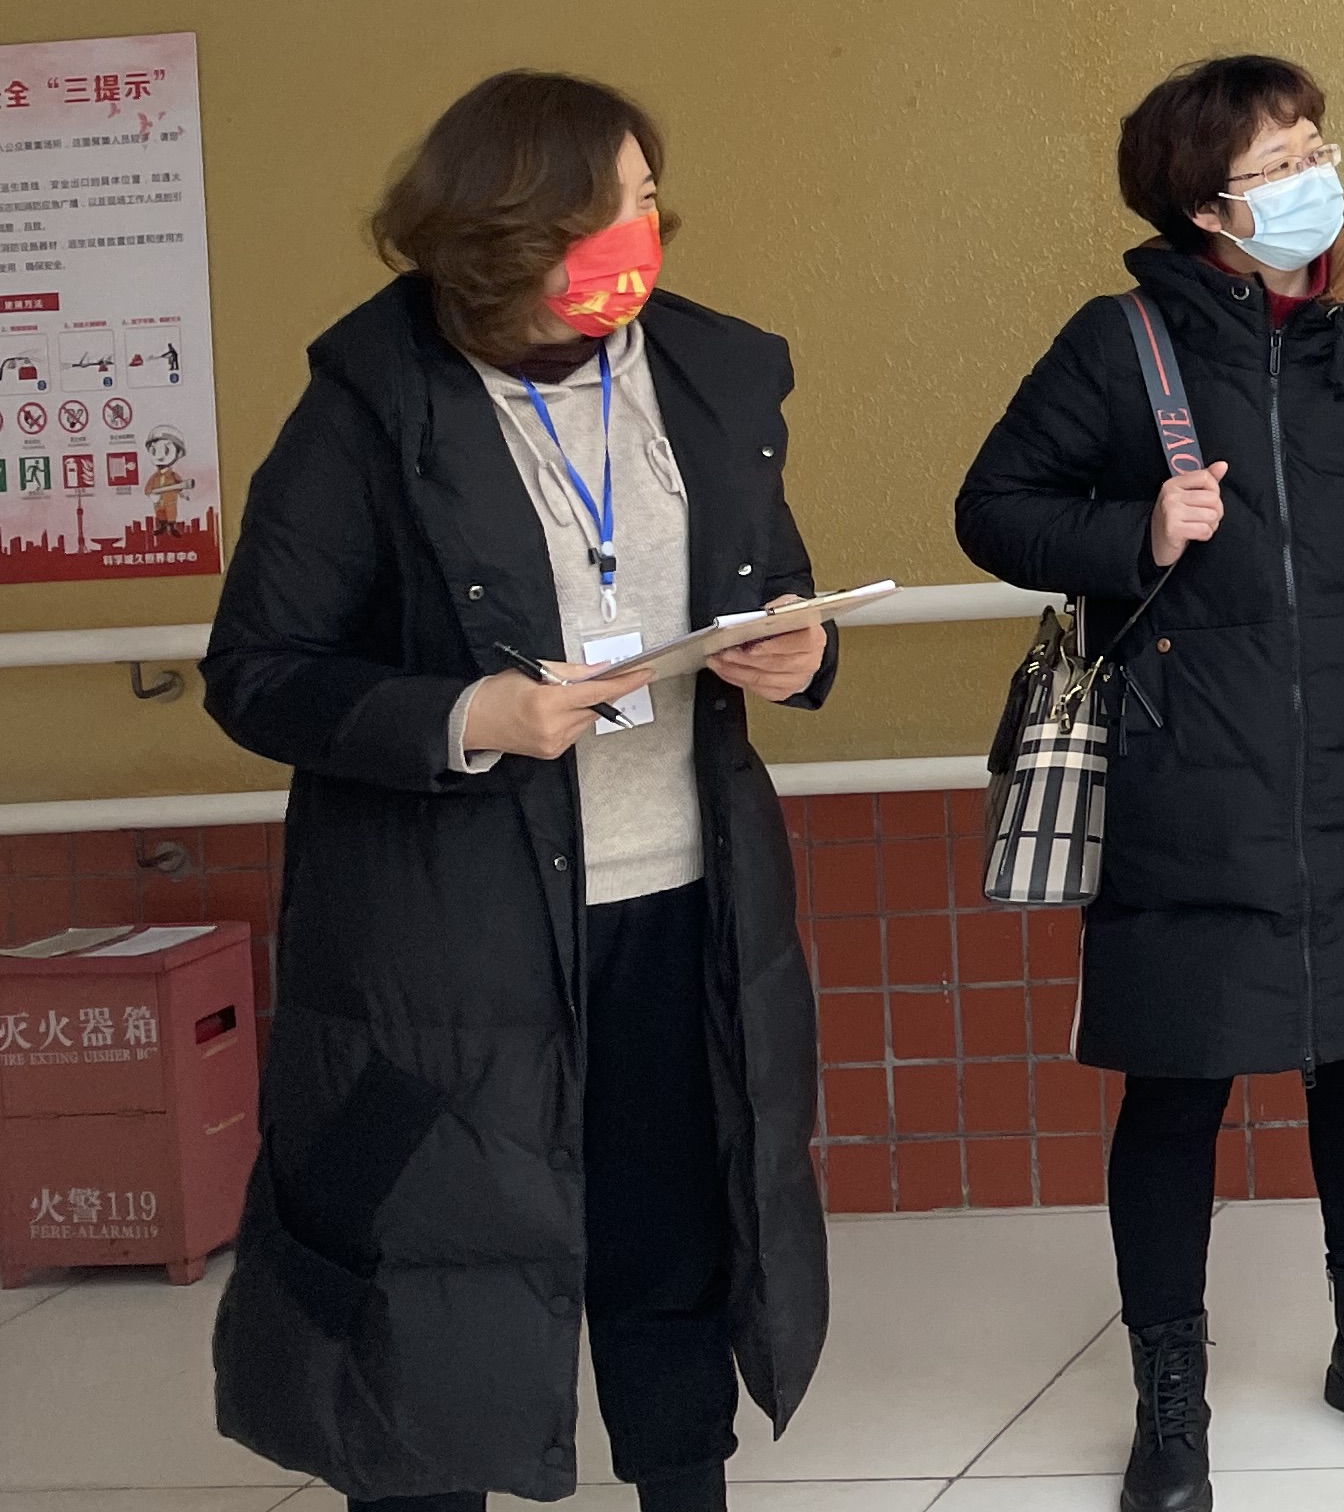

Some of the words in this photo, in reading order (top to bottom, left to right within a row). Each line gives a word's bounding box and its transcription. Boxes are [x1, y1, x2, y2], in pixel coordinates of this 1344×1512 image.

[0, 69, 166, 108] 全“三提示”
[1156, 406, 1203, 476] OVE
[0, 1005, 158, 1051] 灭火器箱
[30, 1187, 158, 1224] 火警119
